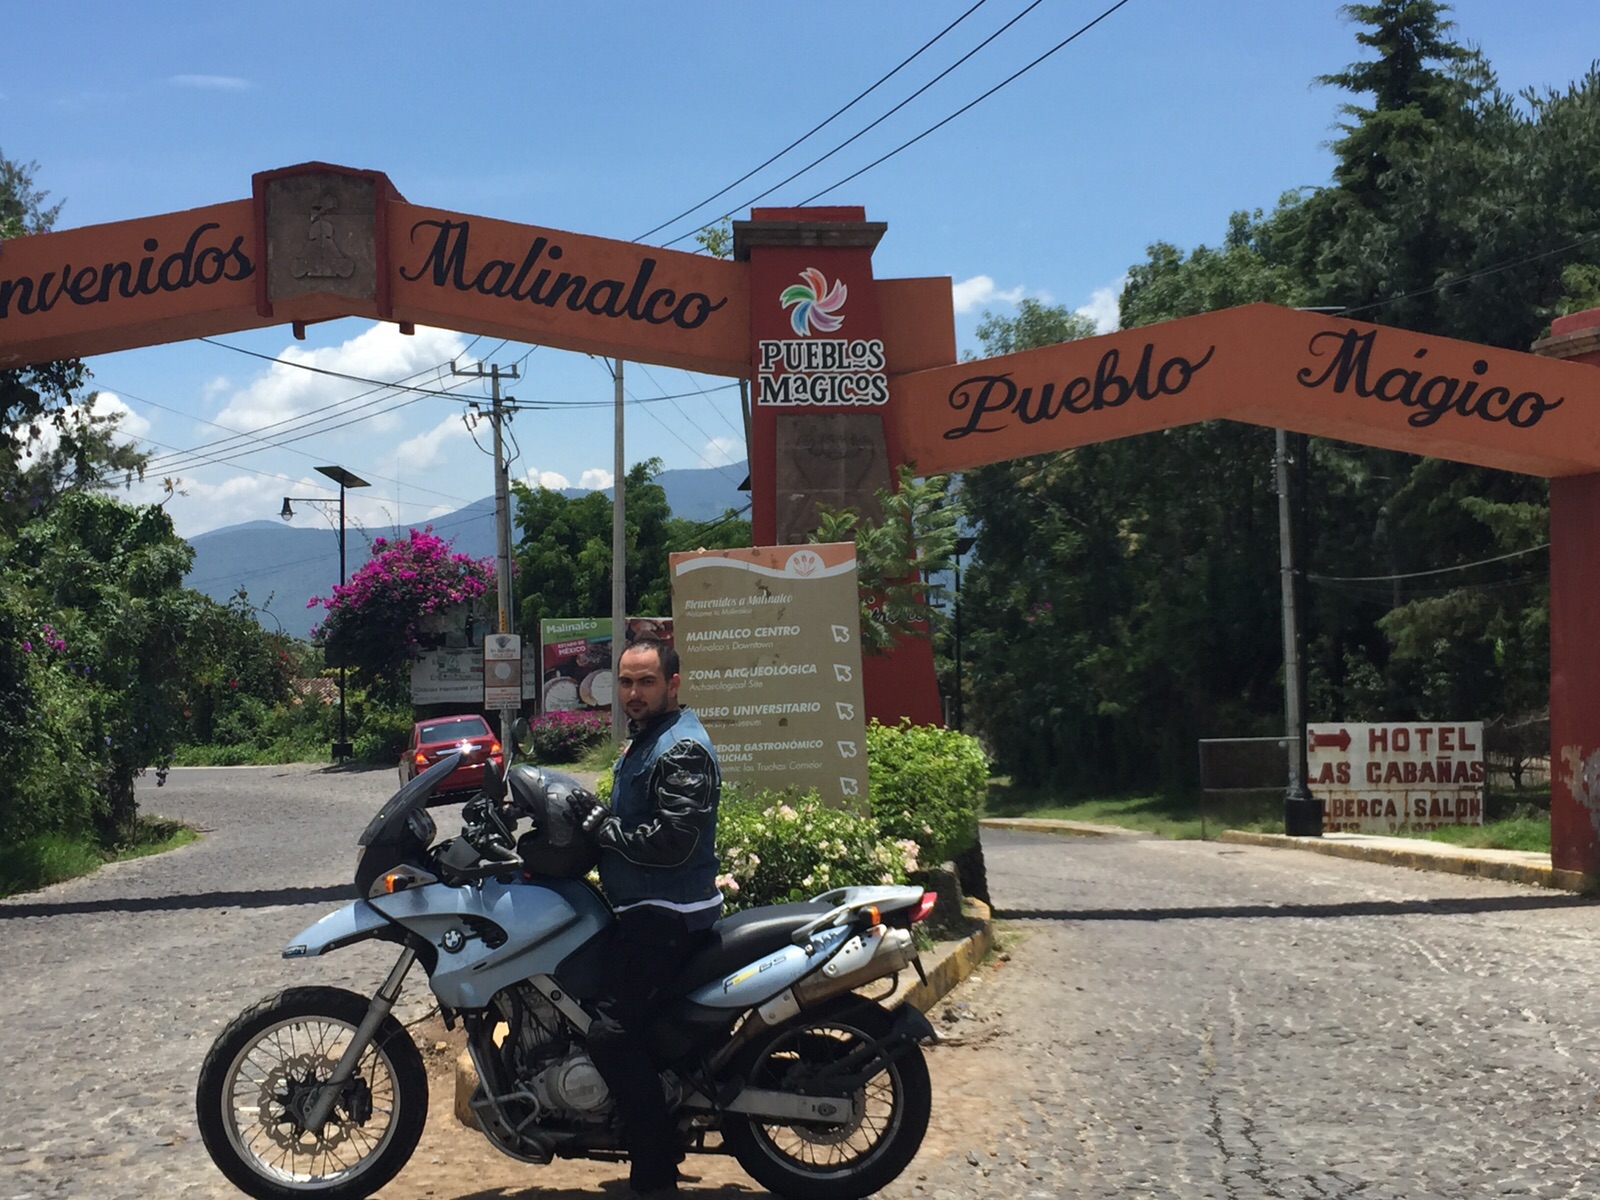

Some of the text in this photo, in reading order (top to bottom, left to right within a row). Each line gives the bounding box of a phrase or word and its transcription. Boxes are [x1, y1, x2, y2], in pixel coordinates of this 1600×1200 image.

[400, 219, 728, 329] Malinalco
[759, 340, 885, 371] PUEBLOS
[943, 328, 1564, 440] Pueblo Mágico
[685, 592, 793, 610] Bienvenidos a Malinalco
[546, 621, 597, 634] Malinalco
[686, 625, 800, 642] MALINALCO CENTRO
[732, 641, 774, 650] Downtown
[689, 664, 817, 680] ZONA ARQUEOLÓGICA
[748, 680, 763, 688] Site
[692, 702, 821, 718] MUSEO UNIVERSITARIO
[744, 740, 824, 752] GASTRONÓMICO
[1368, 727, 1476, 752] HOTEL
[757, 762, 786, 771] Truchas
[1366, 756, 1484, 784] CABAÑAS
